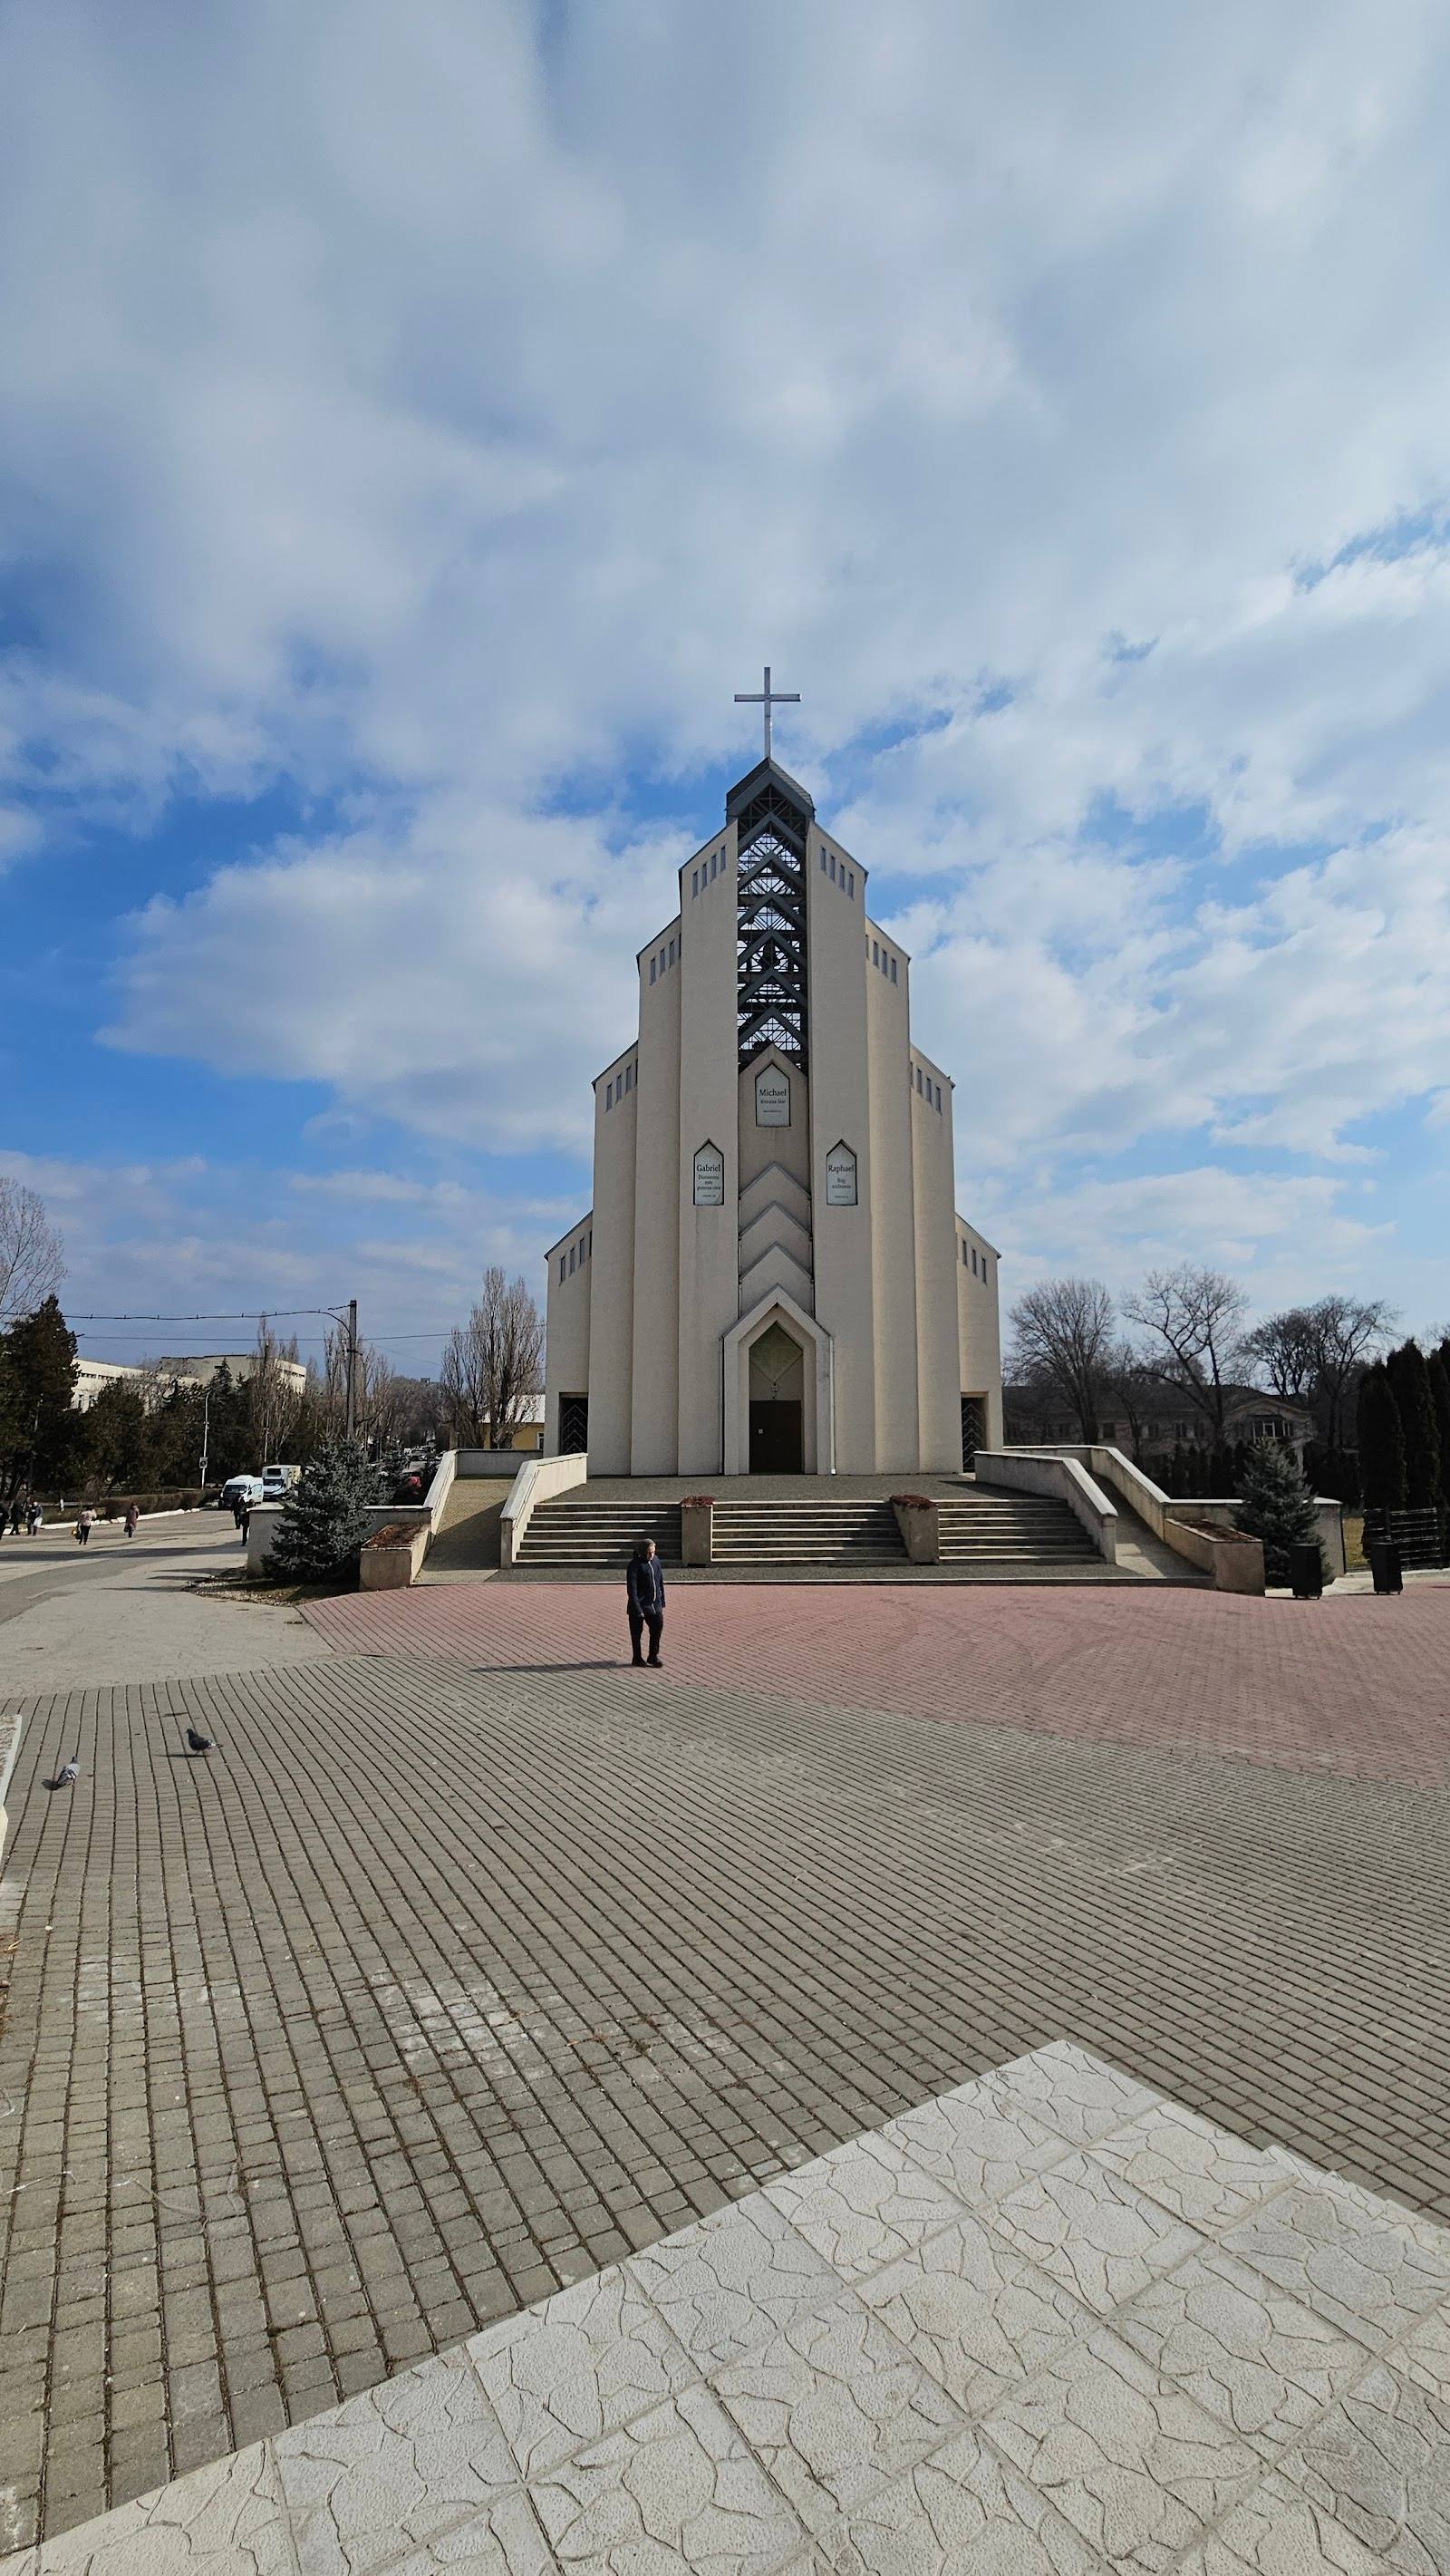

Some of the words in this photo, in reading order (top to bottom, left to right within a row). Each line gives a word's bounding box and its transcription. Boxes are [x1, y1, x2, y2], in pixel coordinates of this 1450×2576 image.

[759, 1088, 787, 1097] Michael
[697, 1164, 720, 1172] Gabriel
[828, 1164, 855, 1174] Raphael
